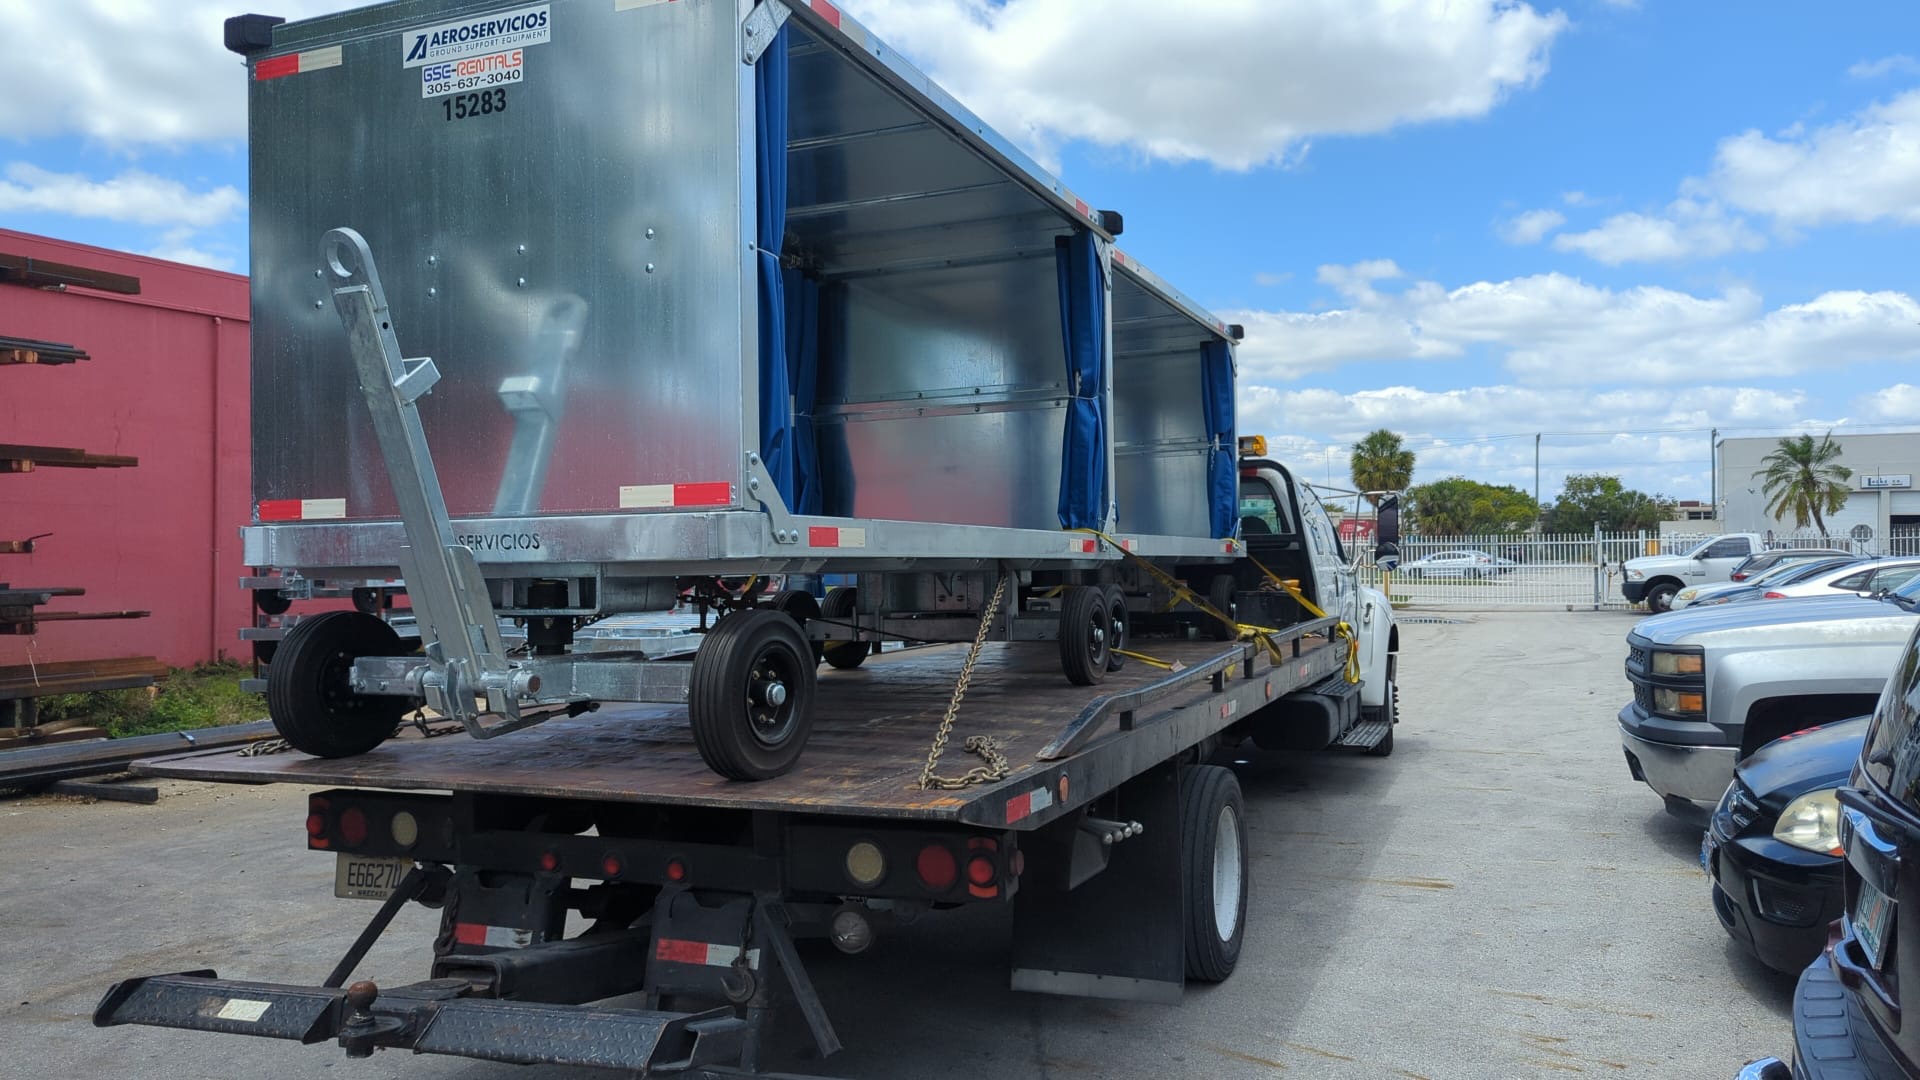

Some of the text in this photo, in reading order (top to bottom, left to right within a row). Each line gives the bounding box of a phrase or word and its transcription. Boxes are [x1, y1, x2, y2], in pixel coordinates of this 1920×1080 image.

[430, 11, 547, 47] AEROSERVICIOS
[429, 30, 547, 58] GROUND SUPPORT EQUIPMENT
[423, 51, 522, 82] GSE-RENTALS
[426, 69, 521, 95] 305-637-3040
[442, 88, 507, 121] 15283
[455, 533, 541, 550] SERVICIOS
